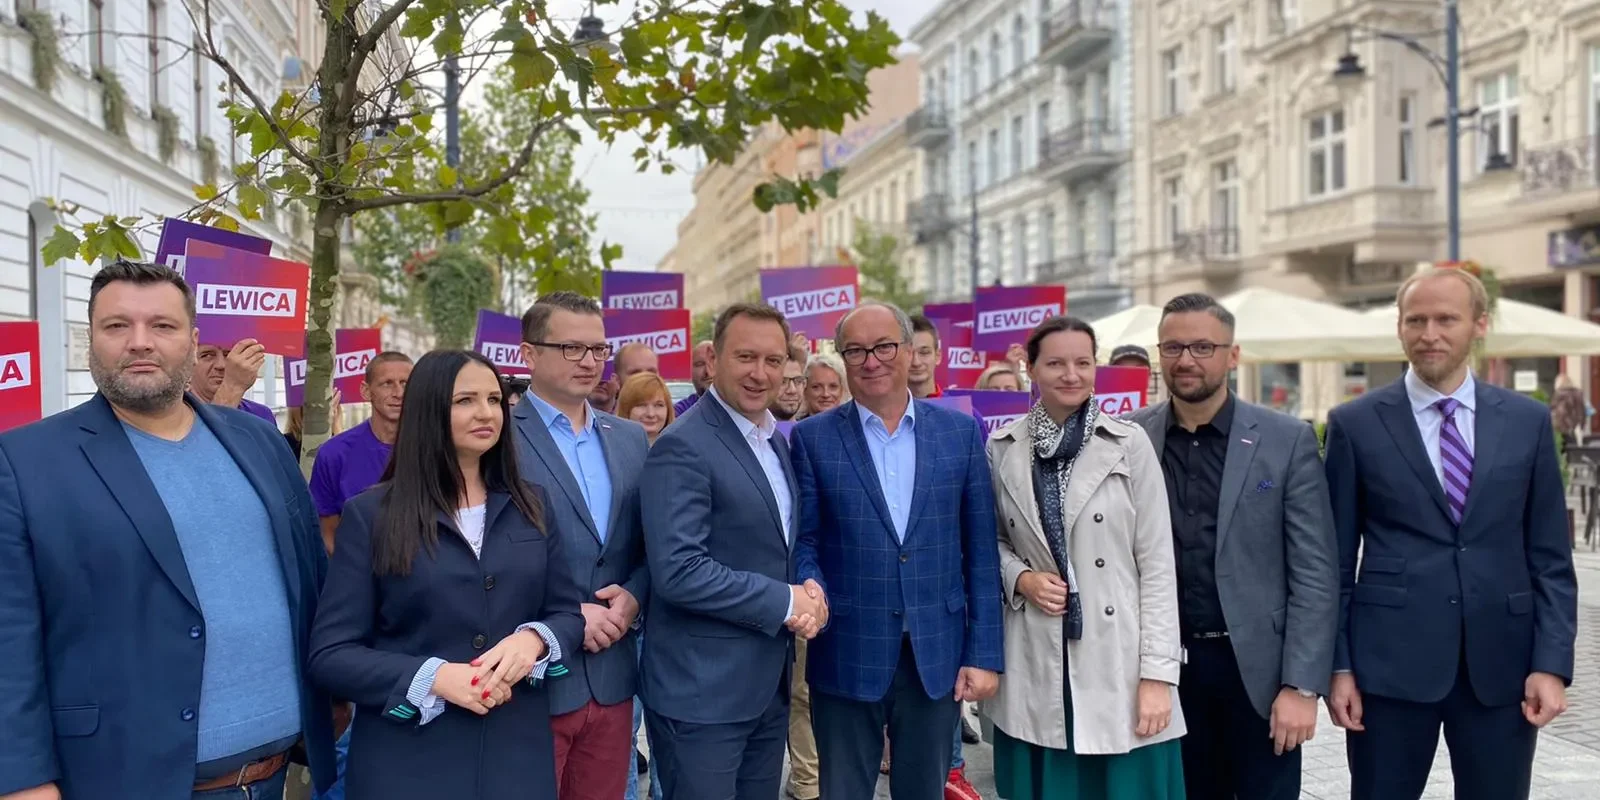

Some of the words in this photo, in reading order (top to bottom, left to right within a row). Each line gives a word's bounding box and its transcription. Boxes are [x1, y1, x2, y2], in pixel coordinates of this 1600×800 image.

[202, 288, 291, 312] LEWICA
[983, 308, 1054, 329] LEWICA
[609, 333, 682, 356] ICA
[949, 350, 982, 365] ICA
